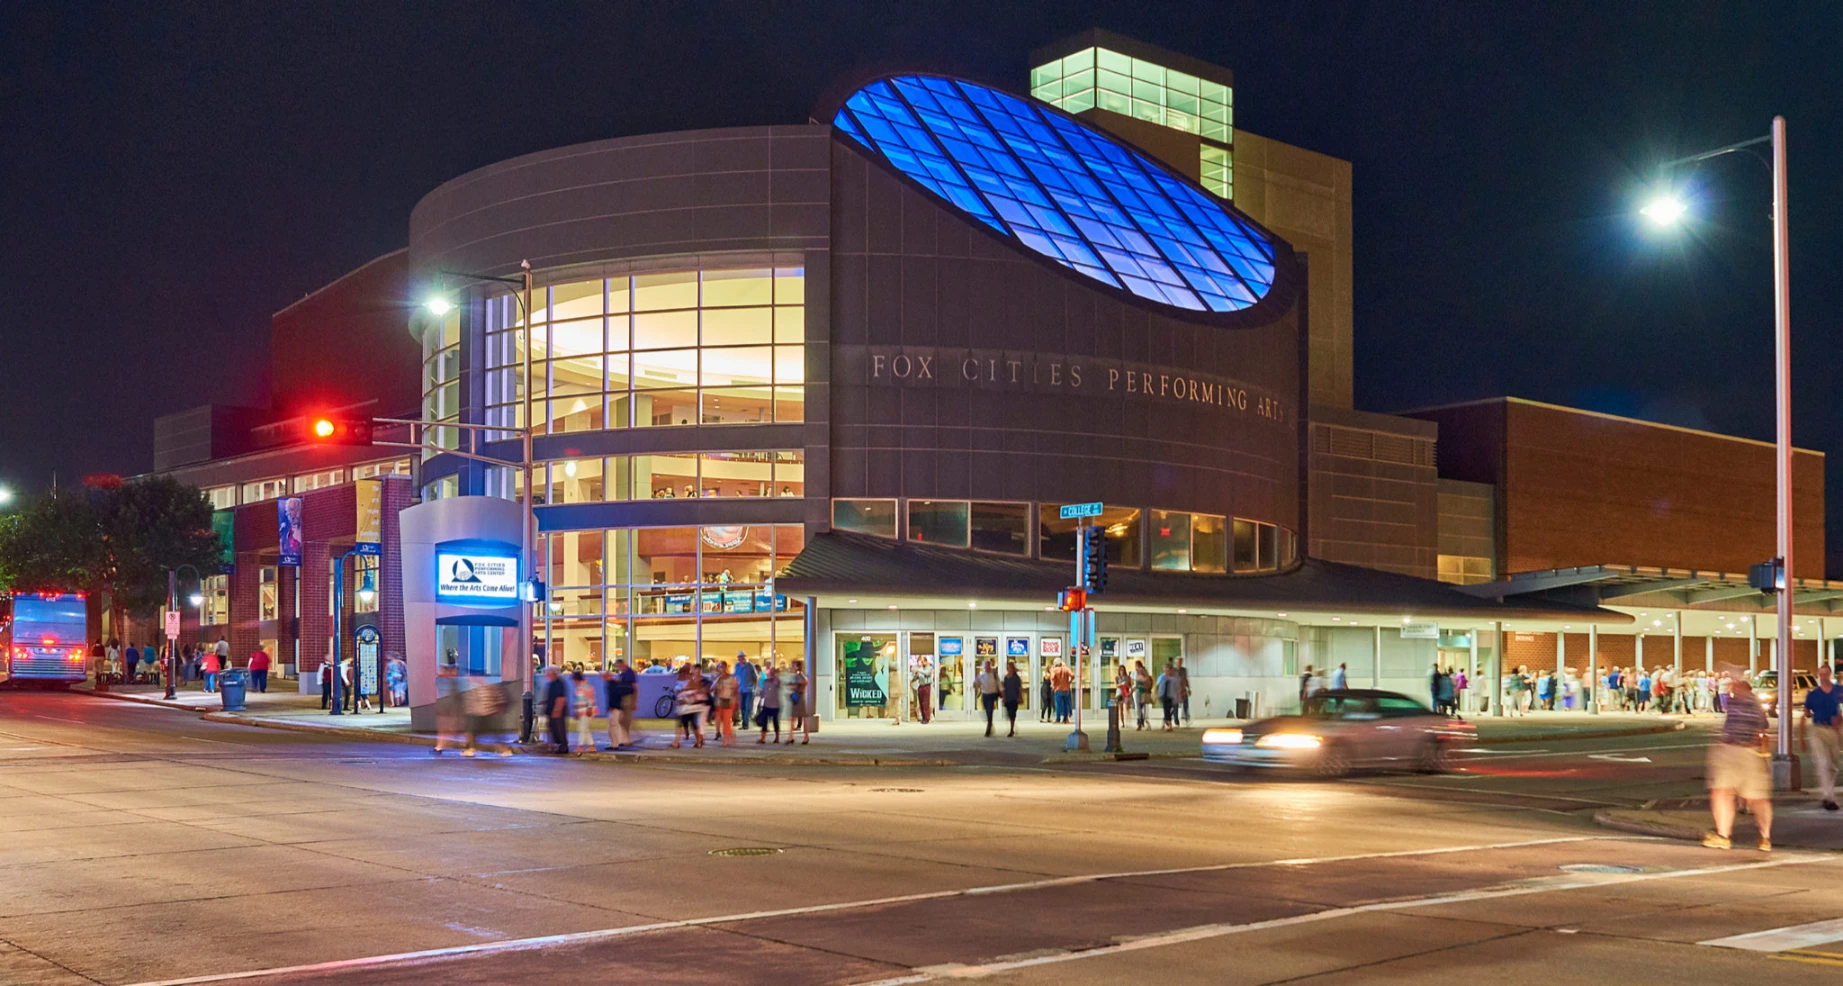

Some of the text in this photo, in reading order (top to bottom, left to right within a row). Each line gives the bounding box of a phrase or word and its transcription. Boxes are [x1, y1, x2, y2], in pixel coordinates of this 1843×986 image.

[872, 354, 933, 379] FOX
[962, 358, 1082, 387] CITIES
[1108, 368, 1247, 411] PERFORMING
[1068, 504, 1092, 516] COLLEGE
[440, 584, 515, 593] Where the Arts Come Alive!
